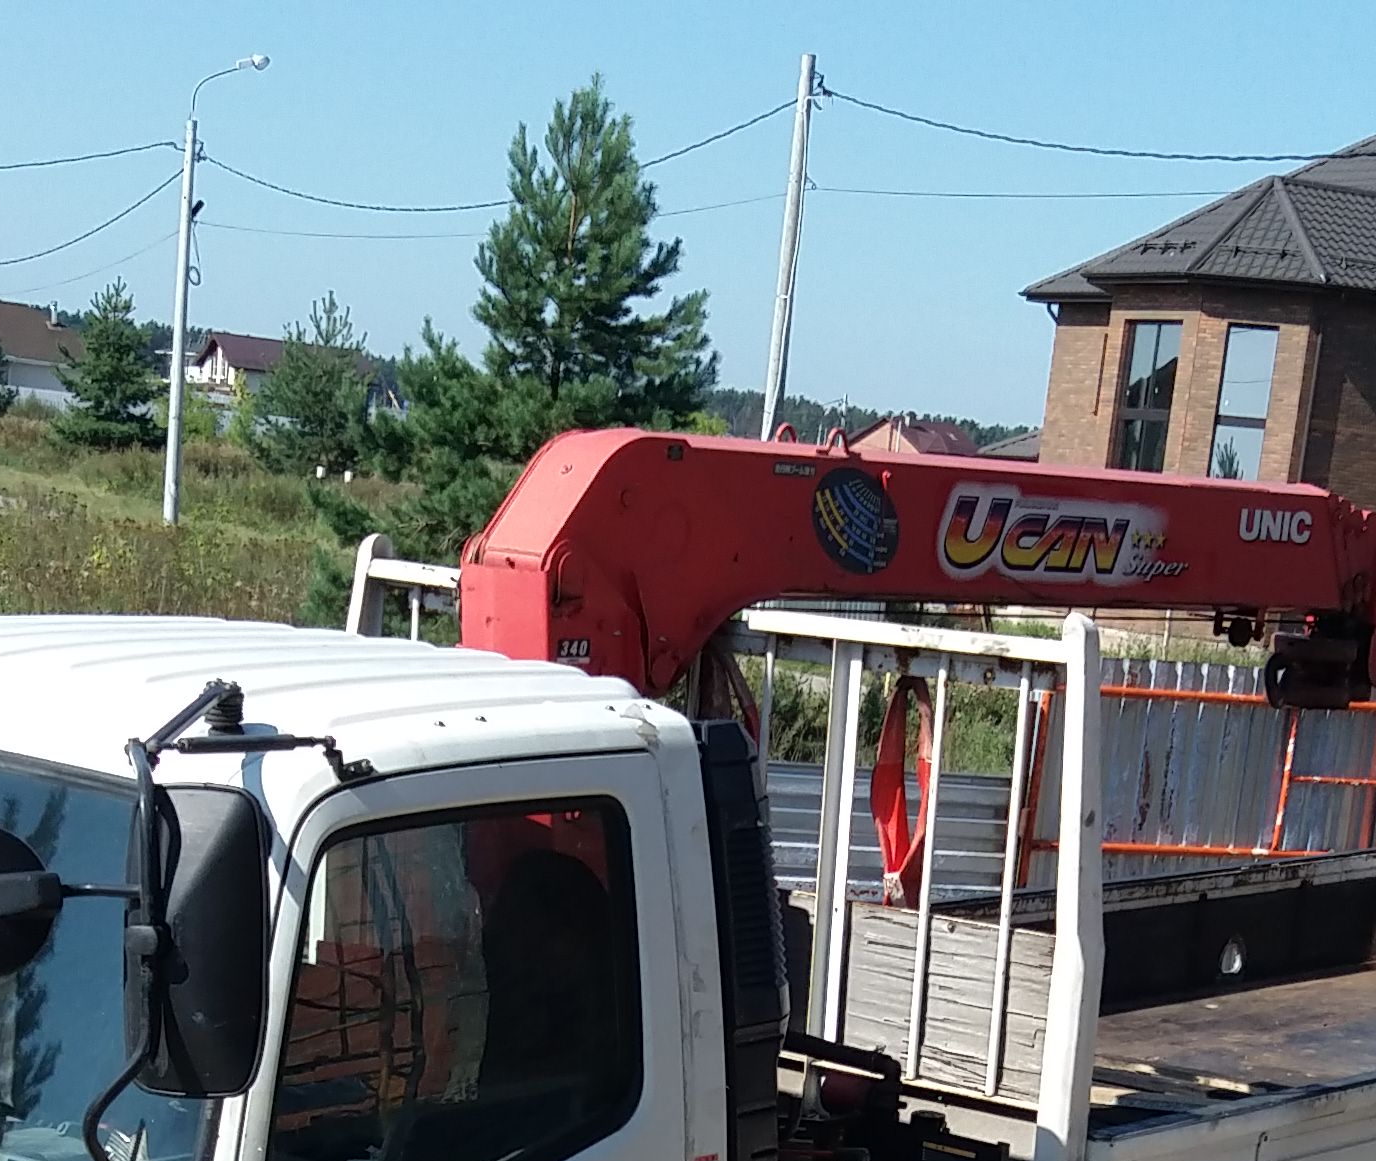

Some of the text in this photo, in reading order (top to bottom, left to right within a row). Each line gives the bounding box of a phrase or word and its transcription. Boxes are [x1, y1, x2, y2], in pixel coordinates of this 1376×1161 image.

[1239, 508, 1312, 544] UNIC
[1123, 553, 1189, 582] Super
[560, 640, 588, 656] 340
